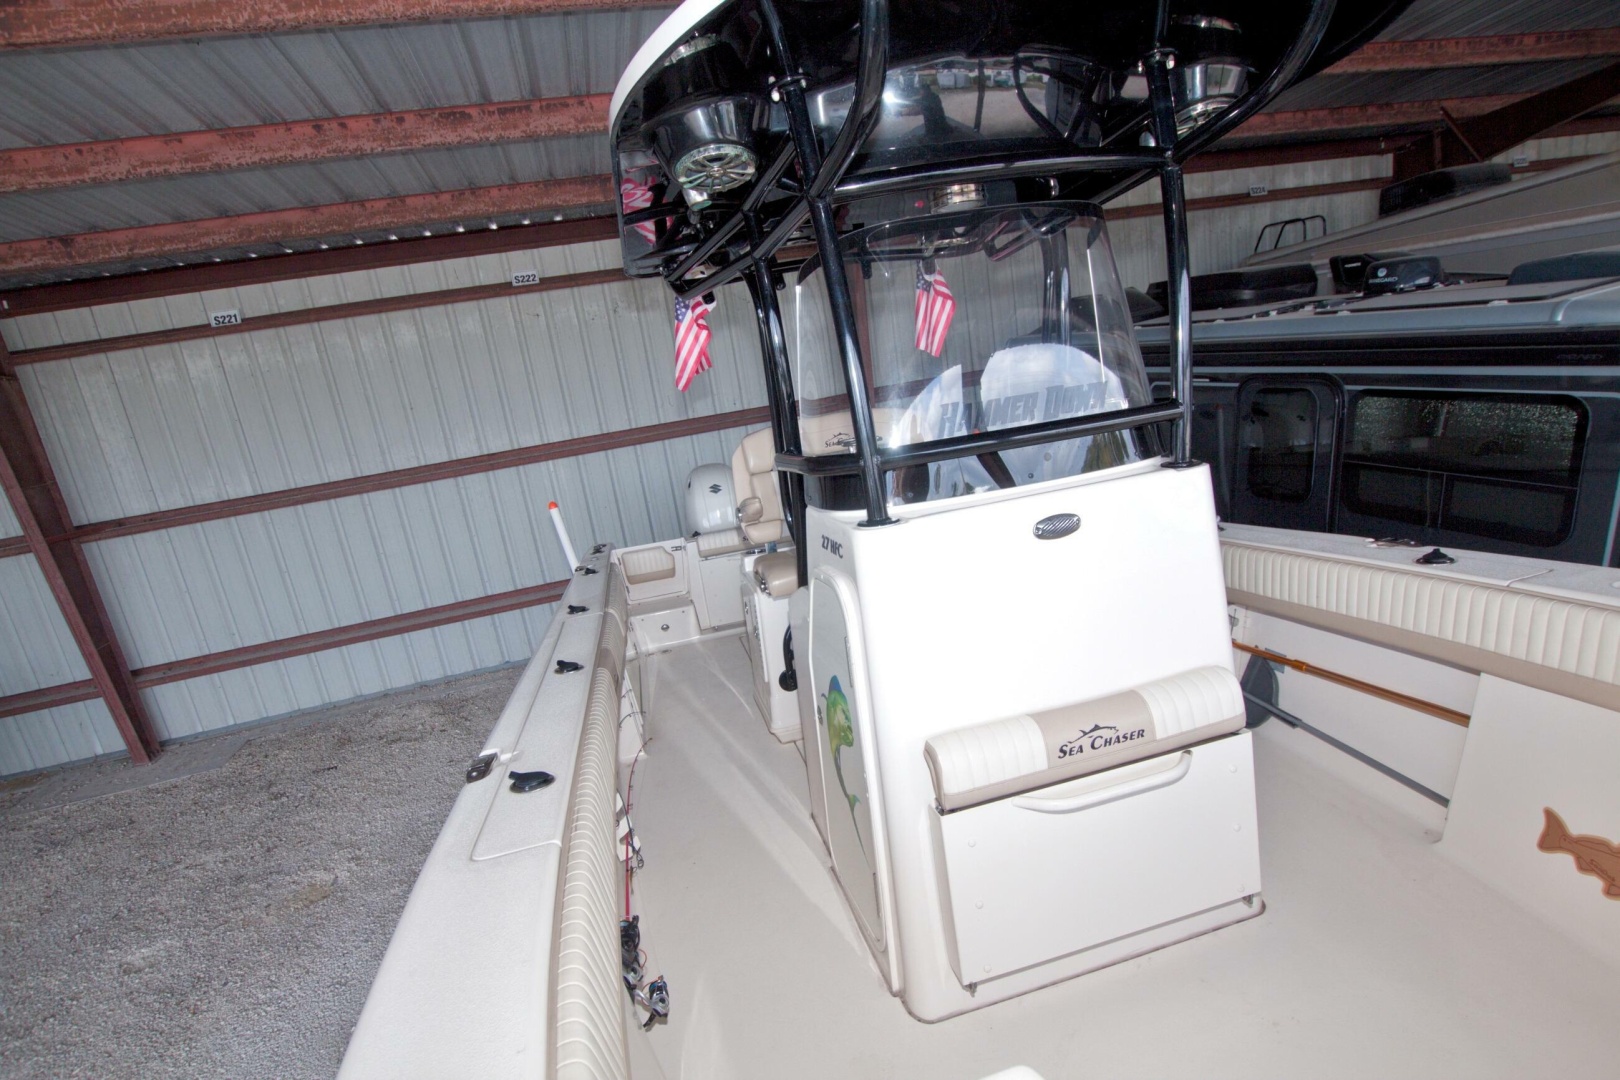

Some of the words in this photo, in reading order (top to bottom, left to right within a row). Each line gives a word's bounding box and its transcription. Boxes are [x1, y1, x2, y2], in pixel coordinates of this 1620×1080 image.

[514, 273, 537, 284] S222
[213, 313, 238, 325] S221
[821, 534, 830, 550] 27
[830, 538, 844, 559] HFC
[1058, 743, 1084, 759] SEA
[1090, 728, 1145, 750] CHASER
